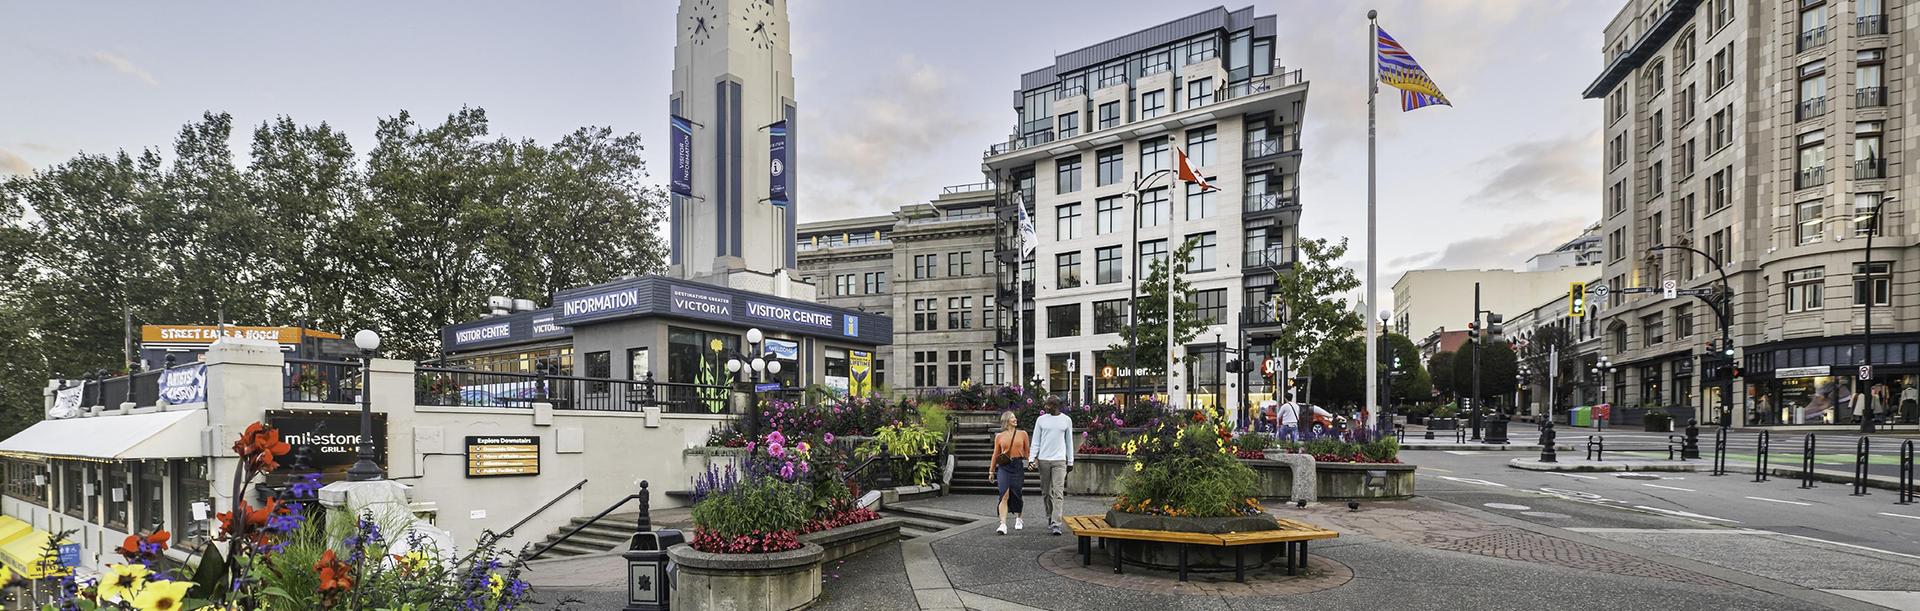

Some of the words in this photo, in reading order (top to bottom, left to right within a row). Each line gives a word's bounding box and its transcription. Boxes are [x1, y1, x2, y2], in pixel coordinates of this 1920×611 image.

[563, 290, 638, 317] INFORMATION
[674, 290, 707, 300] DESTINATION
[708, 296, 729, 304] GREATER
[675, 298, 730, 316] VICTORIA
[748, 302, 791, 320] VISITOR
[792, 310, 832, 326] CENTRE
[161, 328, 201, 339] STREET
[246, 330, 279, 339] HOOCH
[456, 329, 481, 343] VISITOR
[481, 324, 509, 339] CENTRE
[1116, 367, 1166, 377] lullem
[285, 431, 373, 445] milestone
